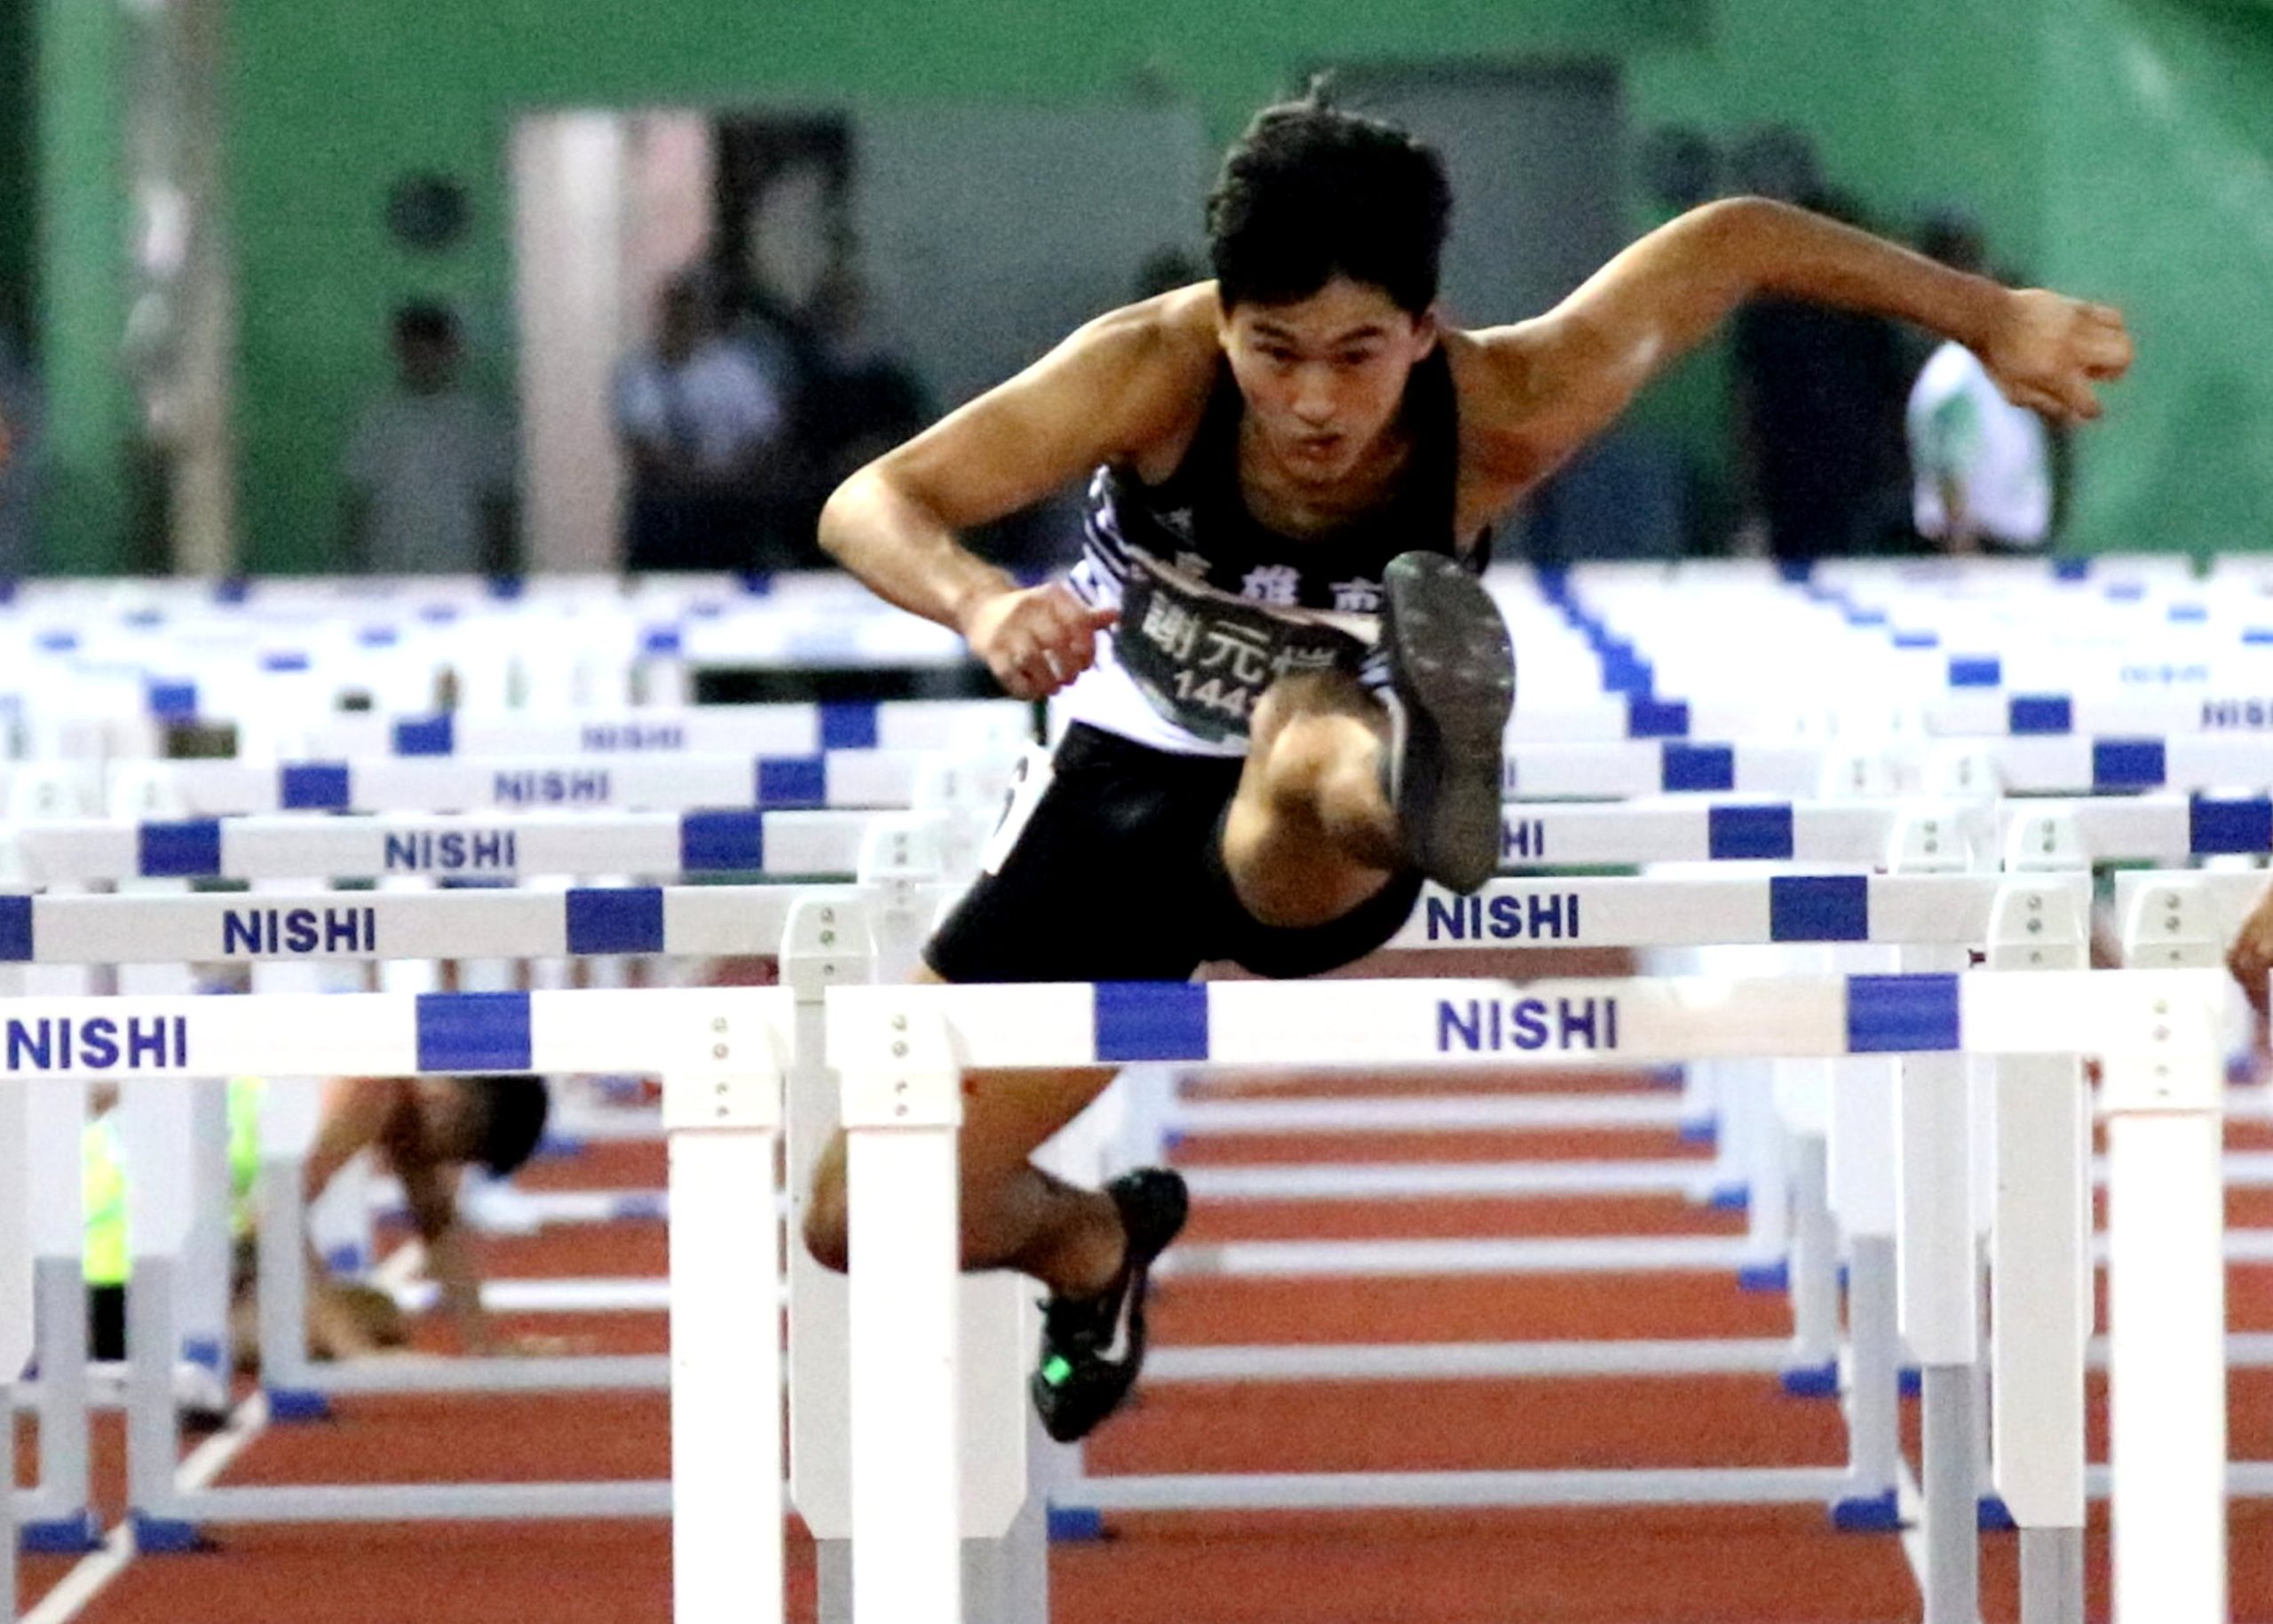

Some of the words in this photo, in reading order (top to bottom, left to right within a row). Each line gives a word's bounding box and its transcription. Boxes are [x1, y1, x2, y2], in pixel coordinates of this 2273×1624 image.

[1173, 669, 1261, 717] 144
[494, 771, 610, 804] NISHI
[384, 831, 516, 869] NISHI
[224, 907, 376, 955] NISHI
[1427, 893, 1579, 940] NISHI
[7, 1016, 186, 1070] NISHI
[1439, 997, 1618, 1051] NISHI
